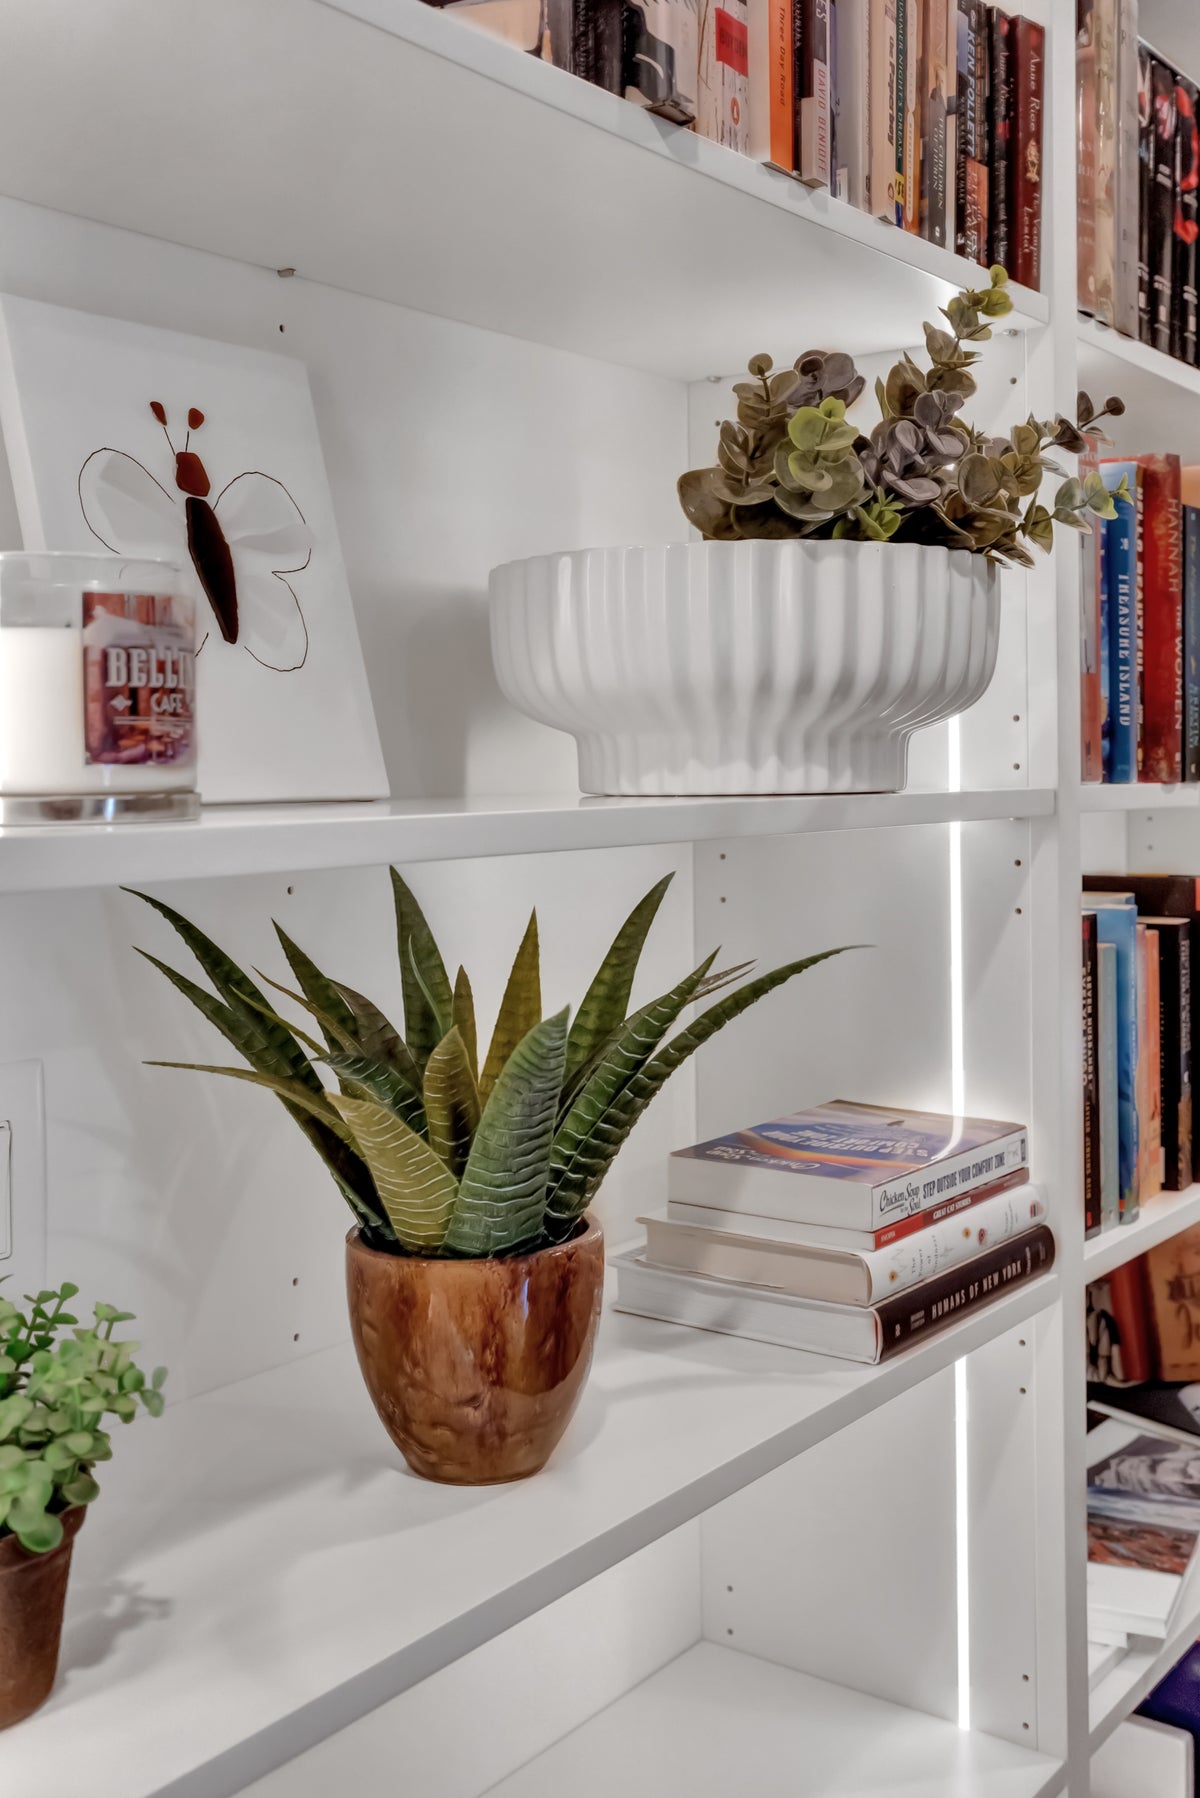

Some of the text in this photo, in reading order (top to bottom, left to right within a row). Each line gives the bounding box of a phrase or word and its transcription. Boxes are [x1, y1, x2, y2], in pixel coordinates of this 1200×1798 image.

[777, 48, 787, 67] Day
[778, 69, 787, 106] Road
[887, 61, 896, 146] Paperboy
[966, 29, 976, 157] KEN FOLLETT
[1029, 50, 1041, 132] Anne Rice
[817, 68, 828, 174] DAVID BENIOFF
[1022, 206, 1031, 253] Lestat
[1032, 215, 1041, 277] Vampire
[1136, 485, 1144, 672] HELLO BEAUTIFUL
[1168, 498, 1180, 592] HANNAH
[1174, 635, 1183, 730] WOMEN
[1118, 574, 1131, 726] TREASURE ISLAND
[750, 1156, 821, 1170] Chicken
[800, 1139, 879, 1152] OUTSIDE
[877, 1145, 928, 1157] STEP
[879, 1182, 920, 1212] Chicken Soup
[923, 1151, 1006, 1200] STEP OUTSIDE YOUR COMFORT ZONE
[907, 1198, 921, 1216] Soul
[931, 1288, 966, 1321] HUMANS
[969, 1281, 980, 1300] OF
[982, 1271, 1000, 1293] NEW
[1002, 1260, 1022, 1282] YORK
